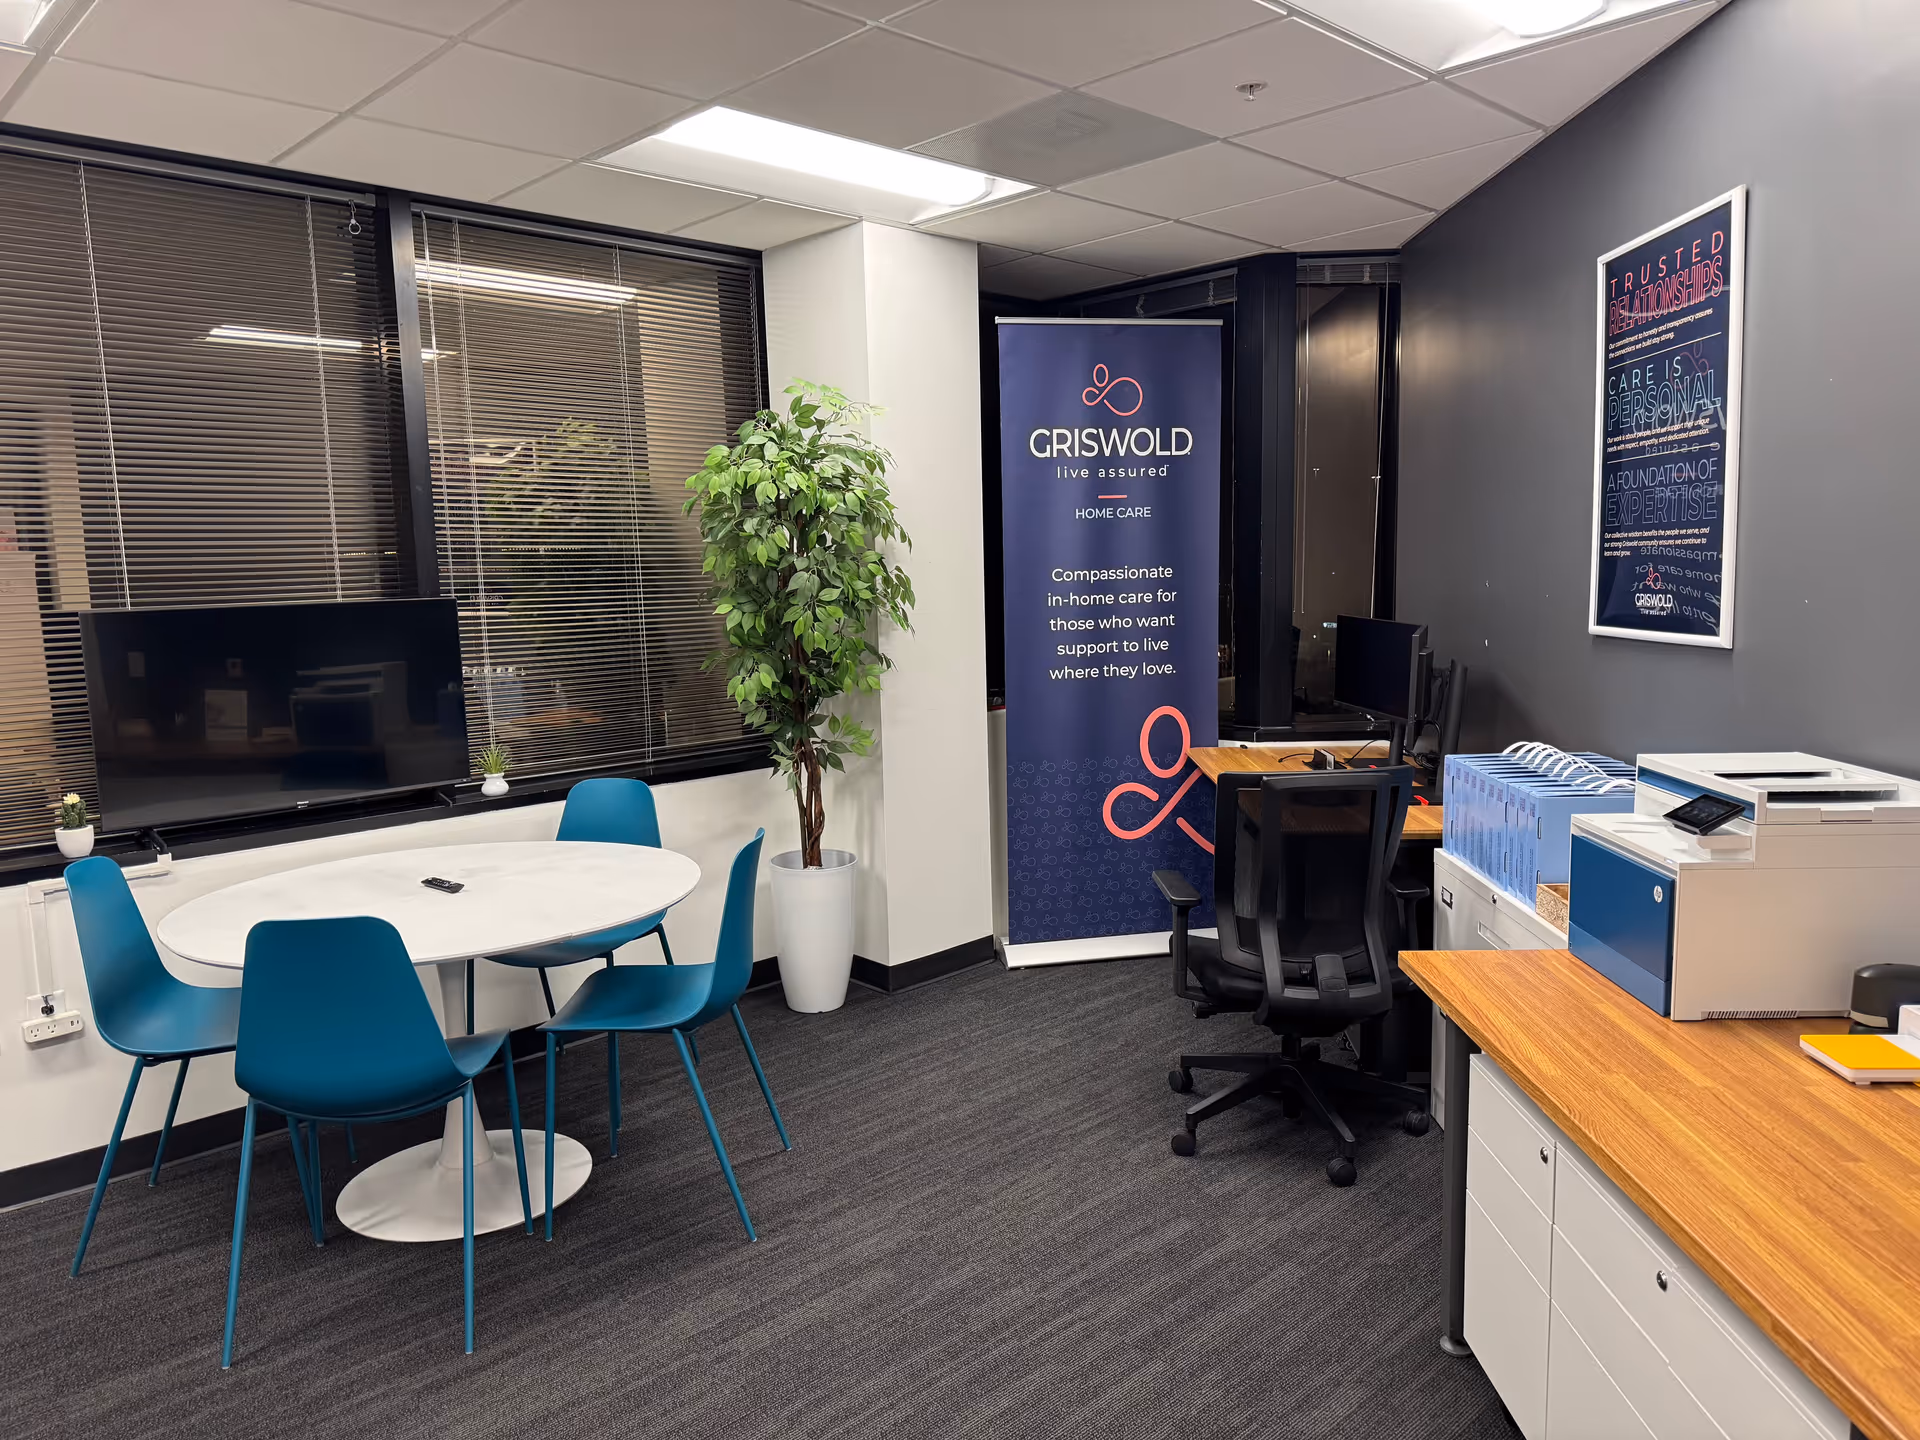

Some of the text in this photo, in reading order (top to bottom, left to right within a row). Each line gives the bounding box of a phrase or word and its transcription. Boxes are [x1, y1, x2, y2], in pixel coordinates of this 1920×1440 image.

[1610, 230, 1724, 298] TRUSTED
[1609, 255, 1723, 336] RELATIONSHIPS
[1615, 334, 1638, 348] commitment
[1643, 328, 1658, 338] honesty
[1667, 315, 1694, 329] transparency
[1615, 346, 1635, 356] connections
[1642, 338, 1652, 348] build
[1652, 336, 1660, 345] stay
[1608, 356, 1682, 395] CARE IS
[1608, 369, 1721, 431] PERSONAL
[1626, 432, 1636, 440] about
[1652, 427, 1660, 435] and
[1667, 423, 1684, 432] support
[1694, 417, 1710, 426] unique
[1667, 432, 1688, 441] dedicated
[1029, 428, 1193, 458] GRISWOLD
[1057, 466, 1168, 478] live assured
[1607, 458, 1718, 492] A FOUNDATION OF
[1075, 507, 1152, 519] HOME CARE
[1605, 481, 1718, 526] EXPERTISE
[1611, 531, 1628, 539] collective
[1628, 530, 1642, 538] wisdom
[1643, 529, 1657, 537] benefits
[1665, 528, 1678, 537] people
[1700, 526, 1710, 534] and
[1637, 539, 1659, 547] community
[1682, 537, 1701, 545] continue
[1052, 565, 1173, 584] Compassionate
[1048, 589, 1177, 606] in-home care for
[1635, 593, 1673, 607] GRISWOLD
[1050, 614, 1175, 631] those who want
[1057, 638, 1169, 658] support to live
[1050, 662, 1176, 679] where they love.
